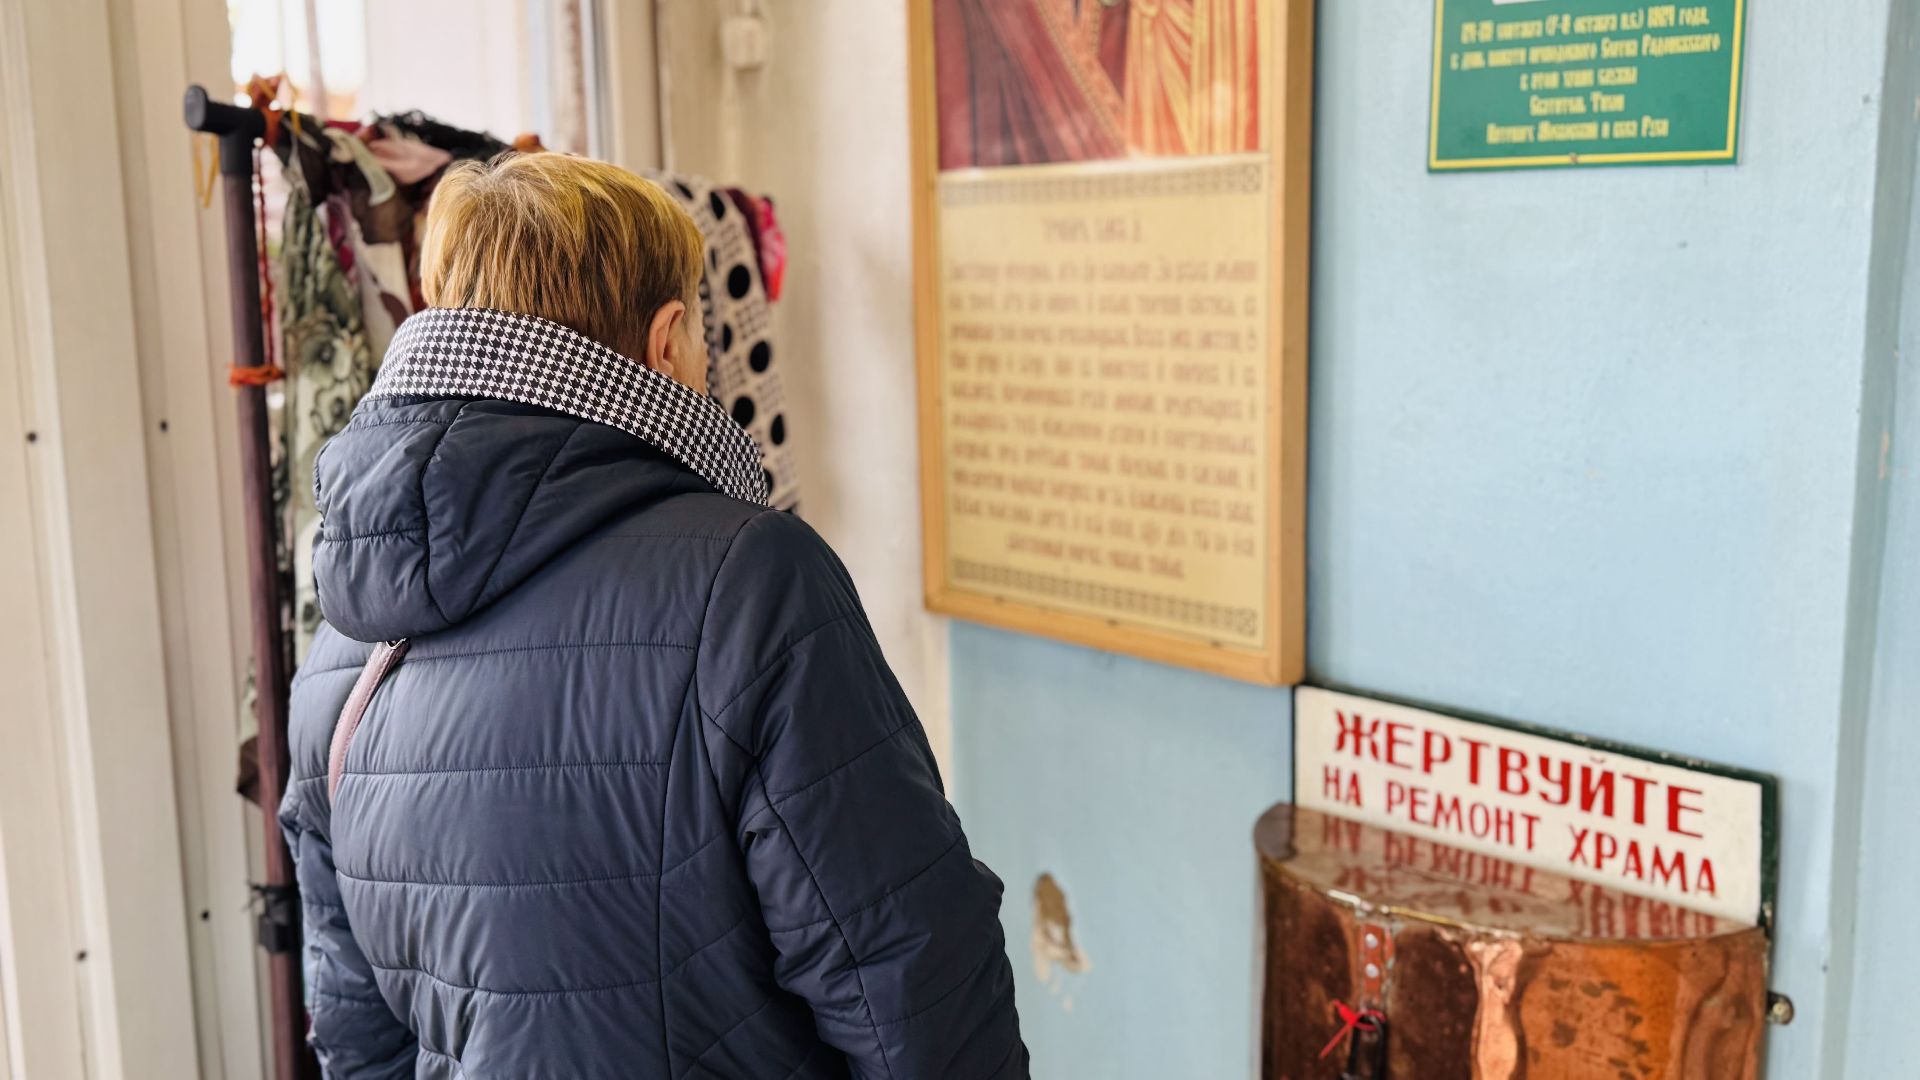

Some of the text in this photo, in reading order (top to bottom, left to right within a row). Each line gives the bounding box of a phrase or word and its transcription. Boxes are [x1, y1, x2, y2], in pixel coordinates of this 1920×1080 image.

[1322, 765, 1719, 899] НА РЕМОНТ ХРАМА
[1335, 708, 1704, 839] ЖЕРТВУЙТЕ
